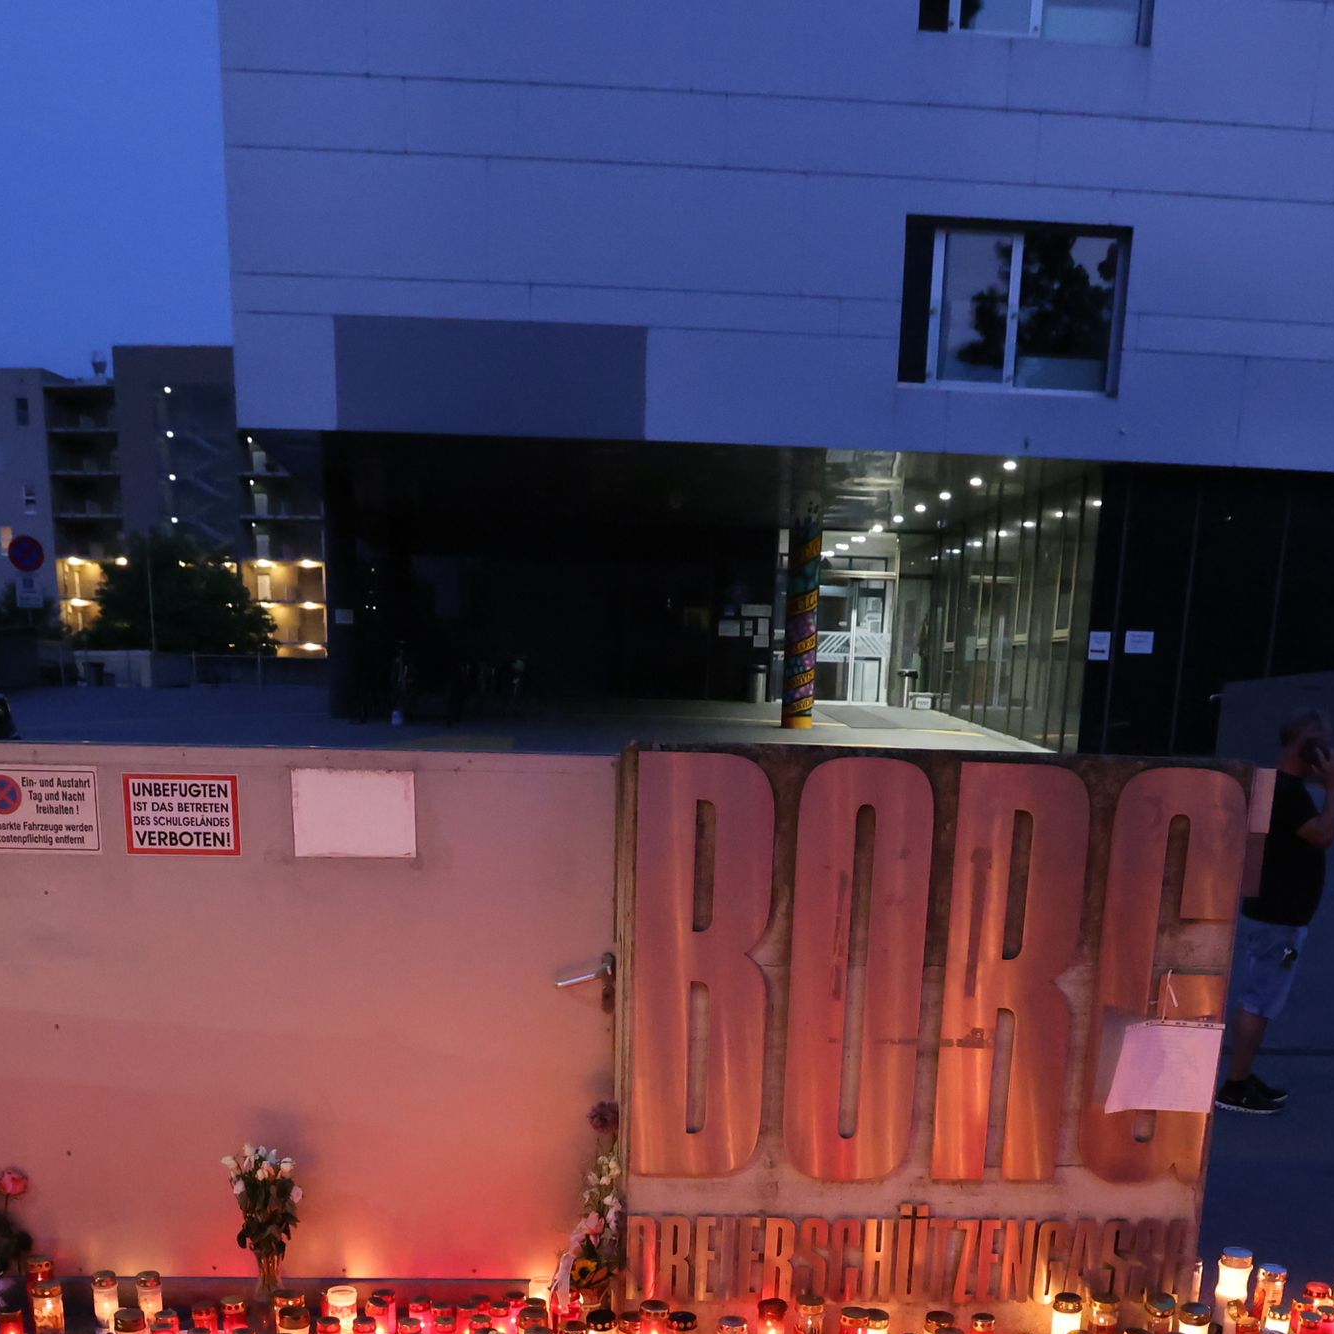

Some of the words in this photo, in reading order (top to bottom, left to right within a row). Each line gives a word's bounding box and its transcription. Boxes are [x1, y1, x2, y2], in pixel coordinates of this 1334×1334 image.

[21, 776, 37, 788] Ein-
[39, 778, 54, 788] und
[56, 777, 91, 789] Ausfahrt
[28, 790, 43, 803] Tag
[44, 790, 59, 801] und
[61, 791, 85, 802] Nacht
[132, 782, 228, 798] UNBEFUGTEN
[36, 804, 75, 815] freihalten
[133, 801, 148, 812] IST
[151, 802, 174, 812] DAS
[177, 802, 229, 813] BETRETEN
[23, 821, 64, 834] Fahrzeuge
[65, 823, 94, 832] werden
[133, 816, 151, 826] DES
[153, 815, 230, 827] SCHULGELÄNDES
[55, 835, 85, 845] entfernt
[135, 831, 231, 847] VERBOTEN!
[629, 751, 1248, 1183] BORG
[626, 1203, 1198, 1304] DREIERSCHÜTZENGASSE
